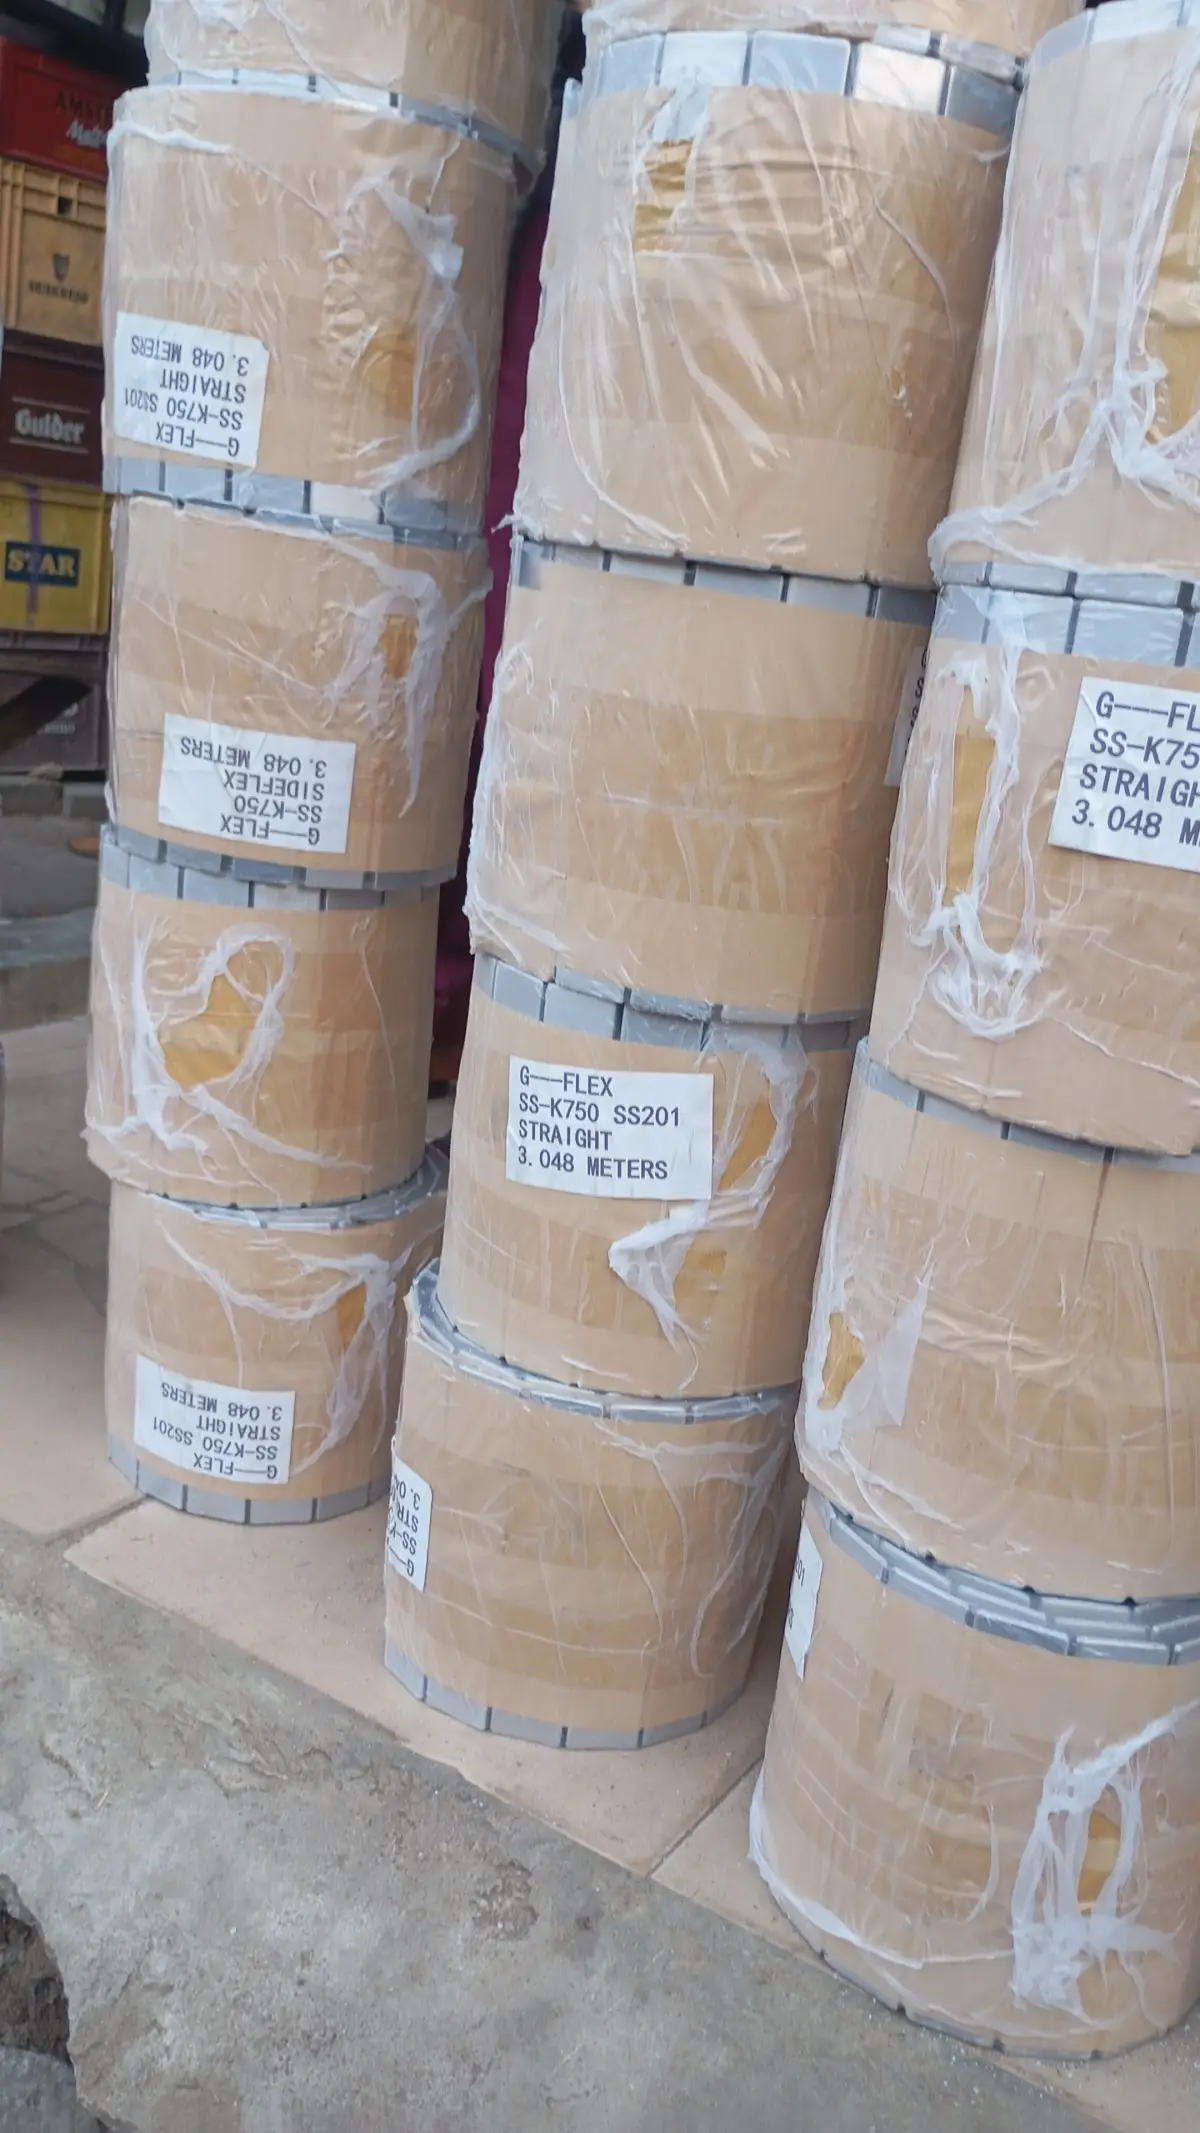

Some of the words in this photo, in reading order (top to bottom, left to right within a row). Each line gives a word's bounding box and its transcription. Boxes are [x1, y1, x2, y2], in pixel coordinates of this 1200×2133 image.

[131, 335, 182, 363] METERS
[124, 388, 158, 413] SS201
[160, 368, 246, 404] STRAIGHT
[15, 408, 85, 444] Gulder
[166, 398, 243, 431] SS-K750
[180, 736, 251, 769] METERS
[223, 769, 325, 801] SIDEFLEX
[234, 795, 322, 824] SS-K750
[519, 1092, 600, 1123] SS-K750
[613, 1105, 679, 1127] SS201
[519, 1119, 613, 1151] STRAIGHT
[587, 1156, 668, 1180] METERS
[161, 1382, 218, 1413] METERS
[153, 1416, 193, 1446] SS201
[196, 1415, 281, 1441] STRAIGHT
[202, 1436, 278, 1461] SS-K750
